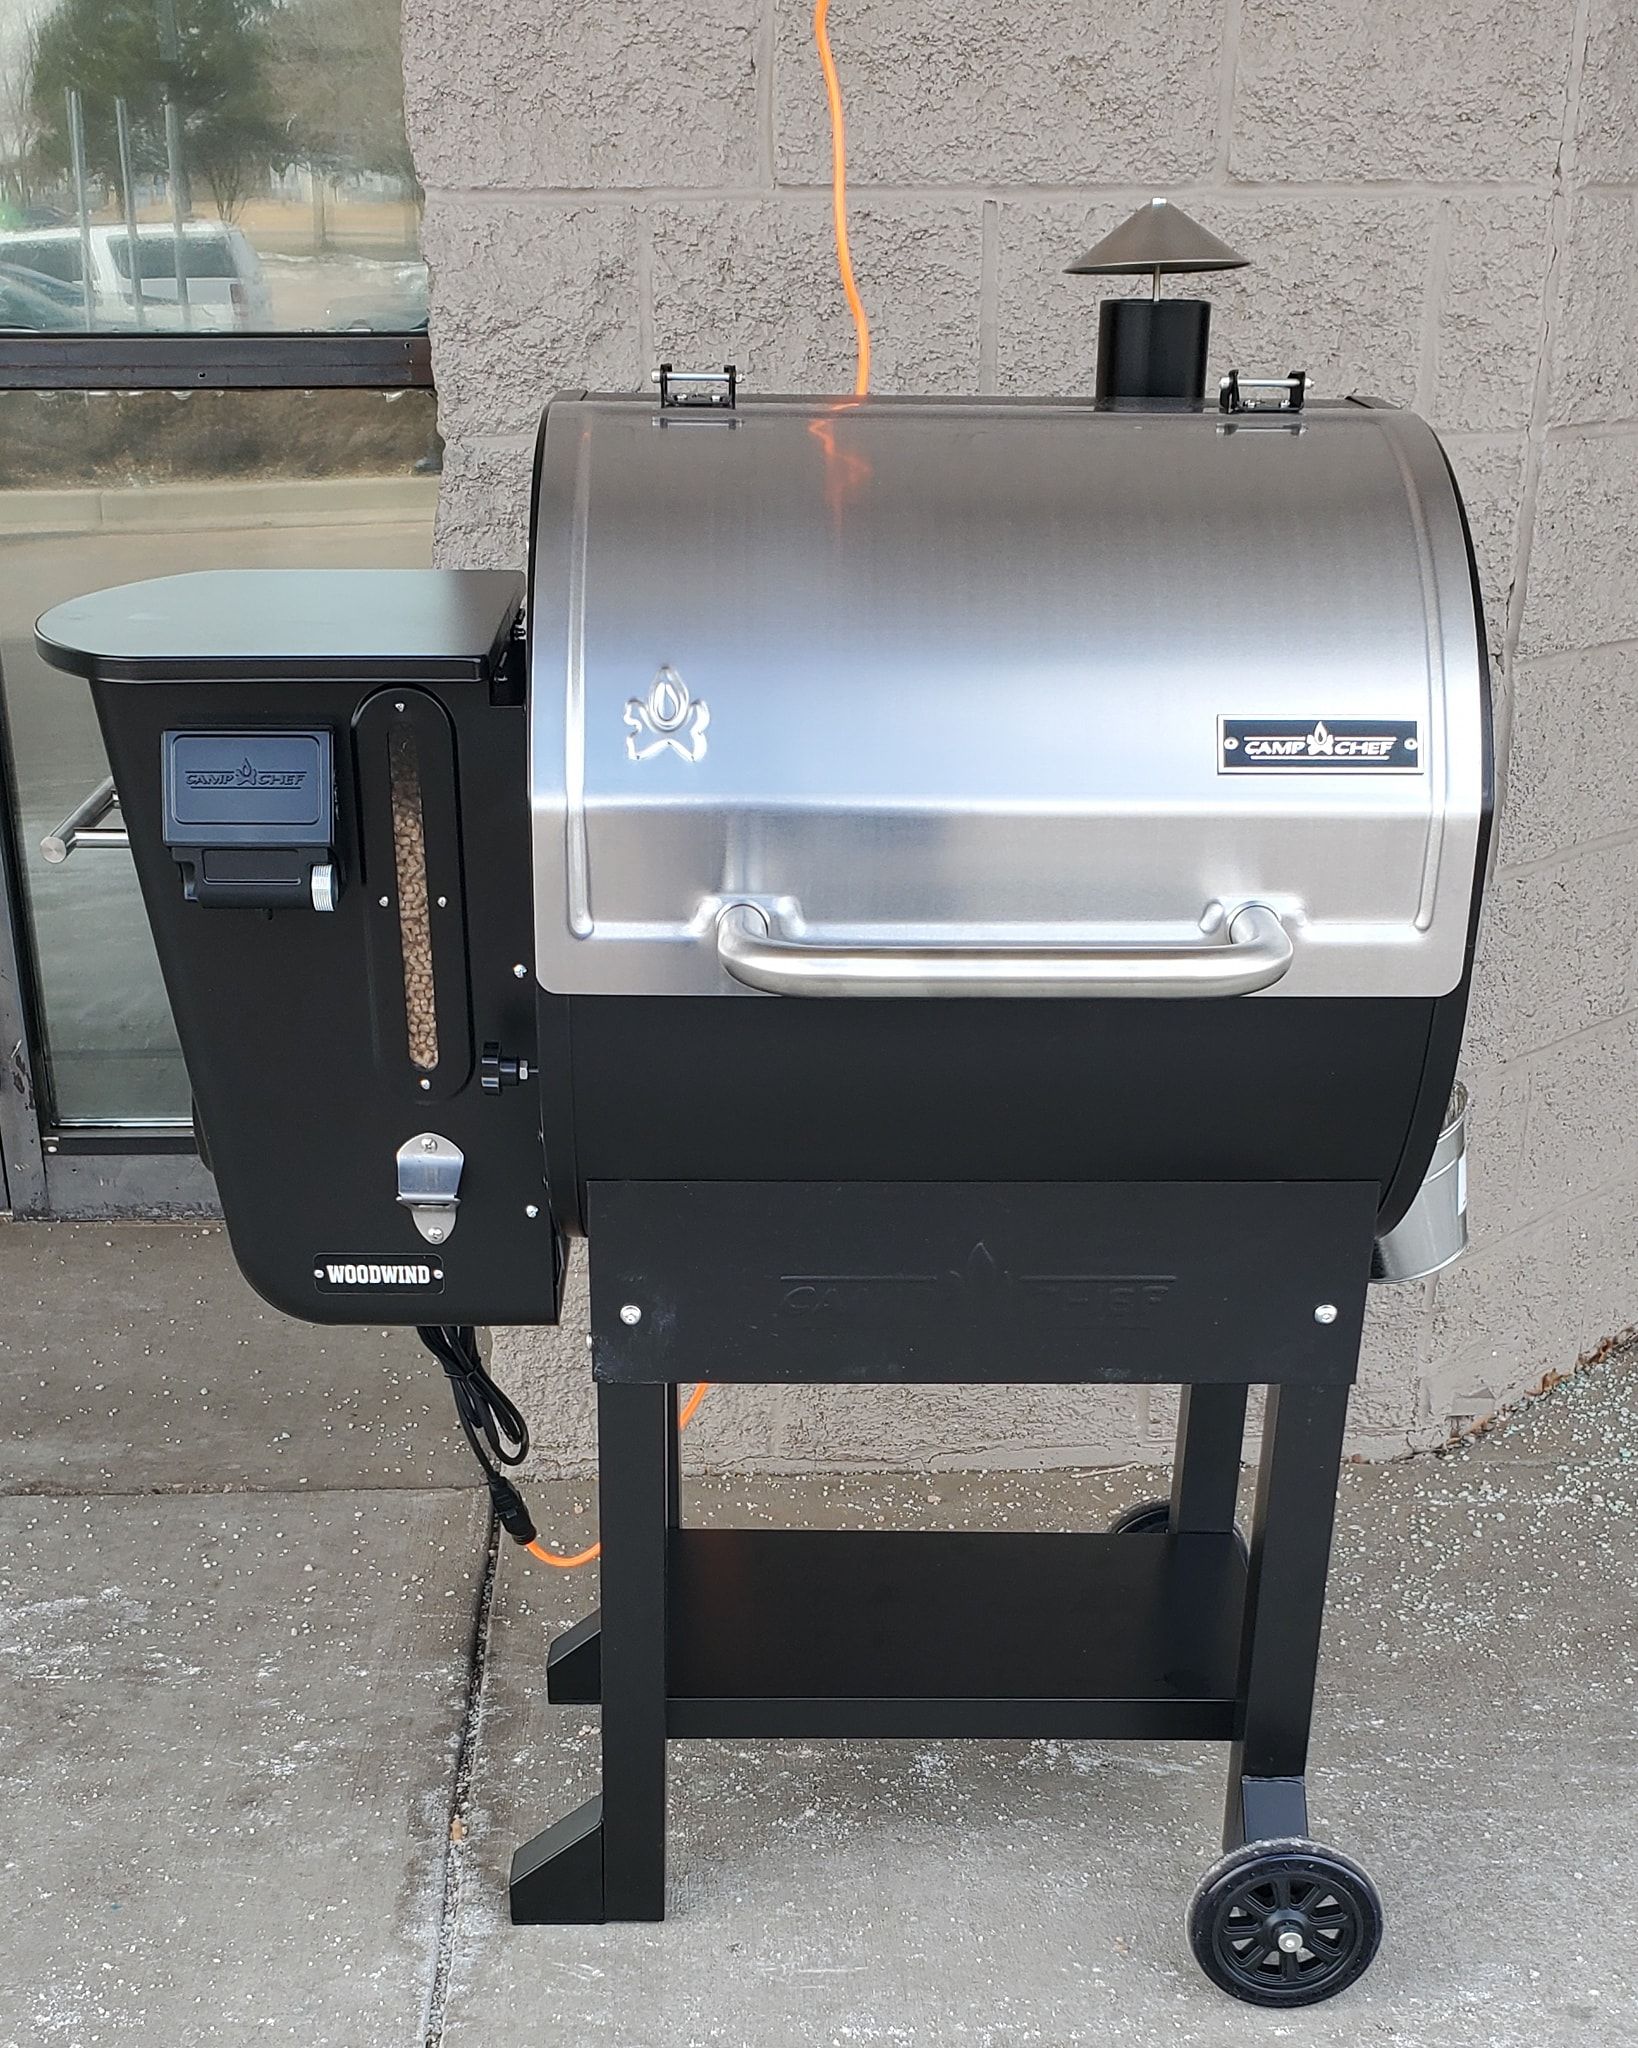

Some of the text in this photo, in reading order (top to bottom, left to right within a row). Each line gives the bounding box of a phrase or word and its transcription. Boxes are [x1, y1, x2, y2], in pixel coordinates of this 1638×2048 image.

[1244, 740, 1395, 755] CAMP CHEF
[185, 774, 306, 786] CAMP CHEF
[326, 1264, 431, 1284] WOODWIND
